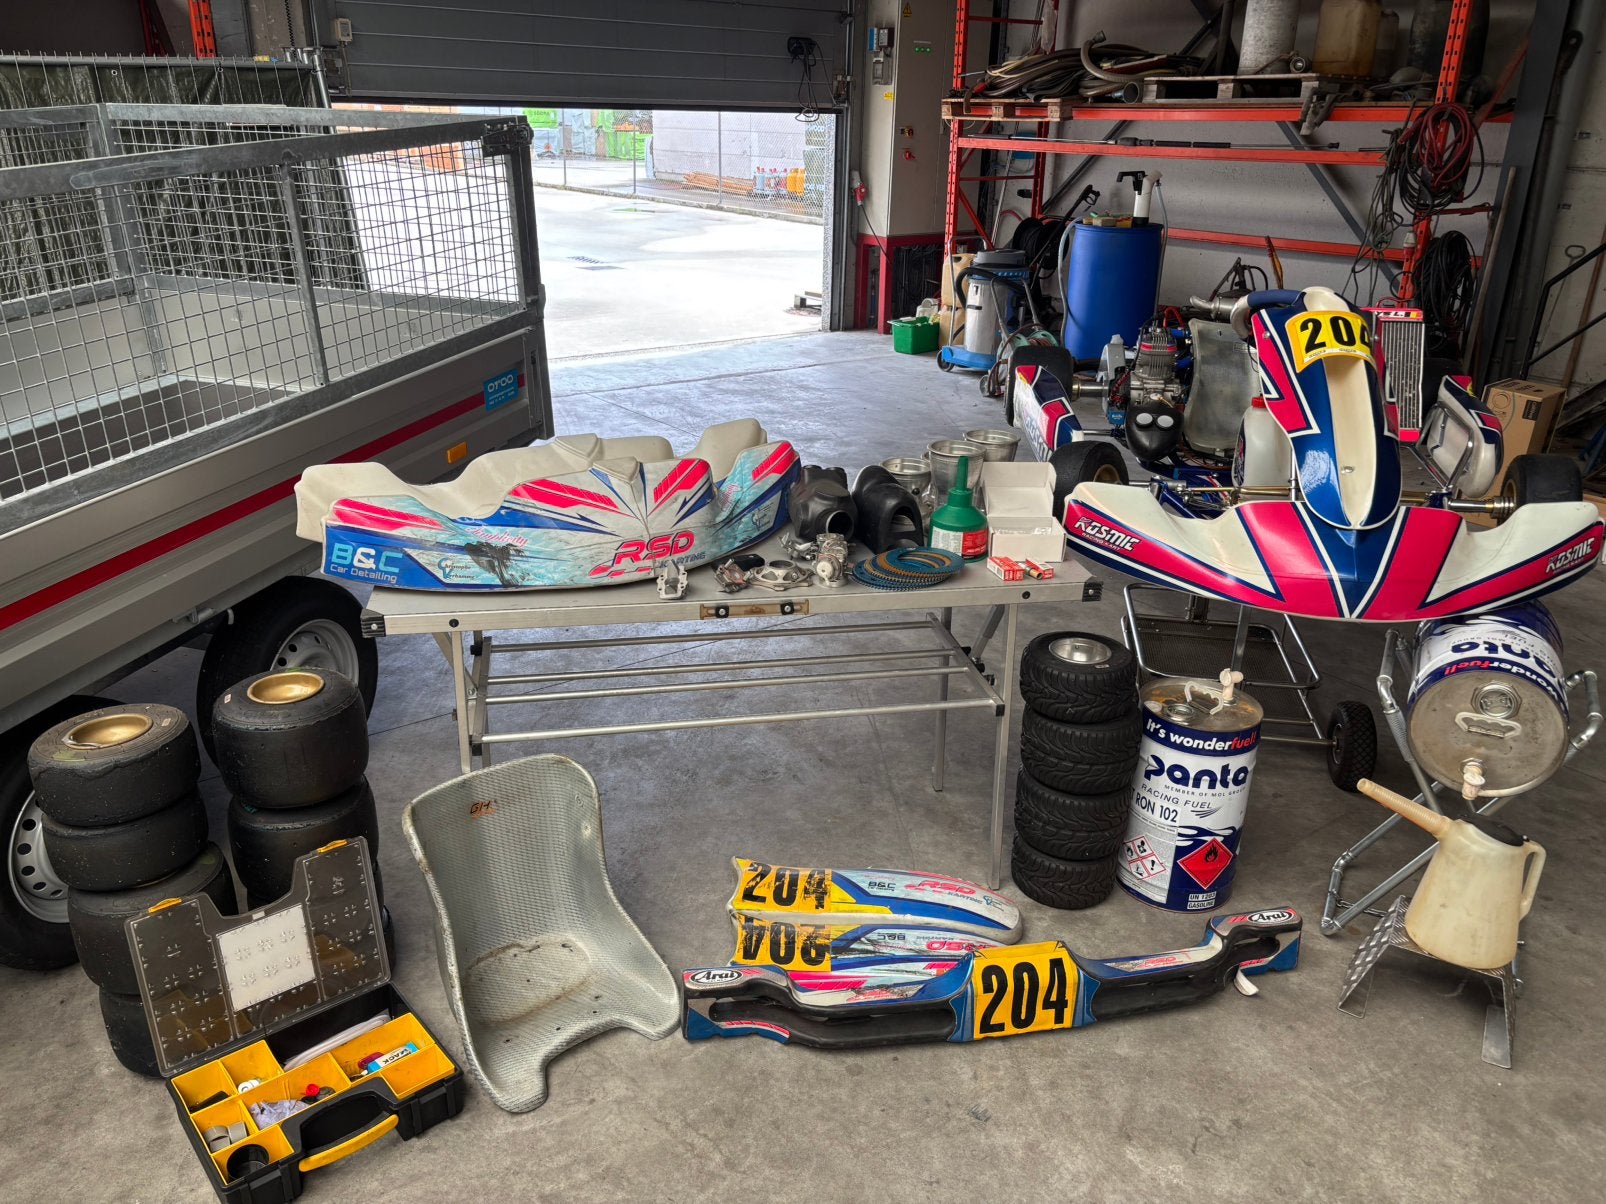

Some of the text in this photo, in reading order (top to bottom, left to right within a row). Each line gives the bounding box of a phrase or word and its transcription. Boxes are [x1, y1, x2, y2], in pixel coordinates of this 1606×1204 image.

[612, 530, 695, 567] RSD
[1074, 516, 1140, 551] KOSMIC
[331, 543, 403, 573] B&C
[1546, 537, 1595, 573] KOSMIC
[330, 565, 397, 585] Car Detailing
[1146, 719, 1257, 751] It's wonderfuel!
[1141, 783, 1179, 805] RACING
[1183, 801, 1213, 810] FUEL
[1164, 785, 1195, 796] MEMBER
[1135, 792, 1156, 815] RON
[1160, 805, 1178, 823] 102
[742, 861, 829, 909] 204
[1188, 900, 1215, 909] GASOLINE
[1258, 911, 1287, 921] Arai
[695, 971, 736, 982] Arai
[980, 957, 1068, 1034] 204
